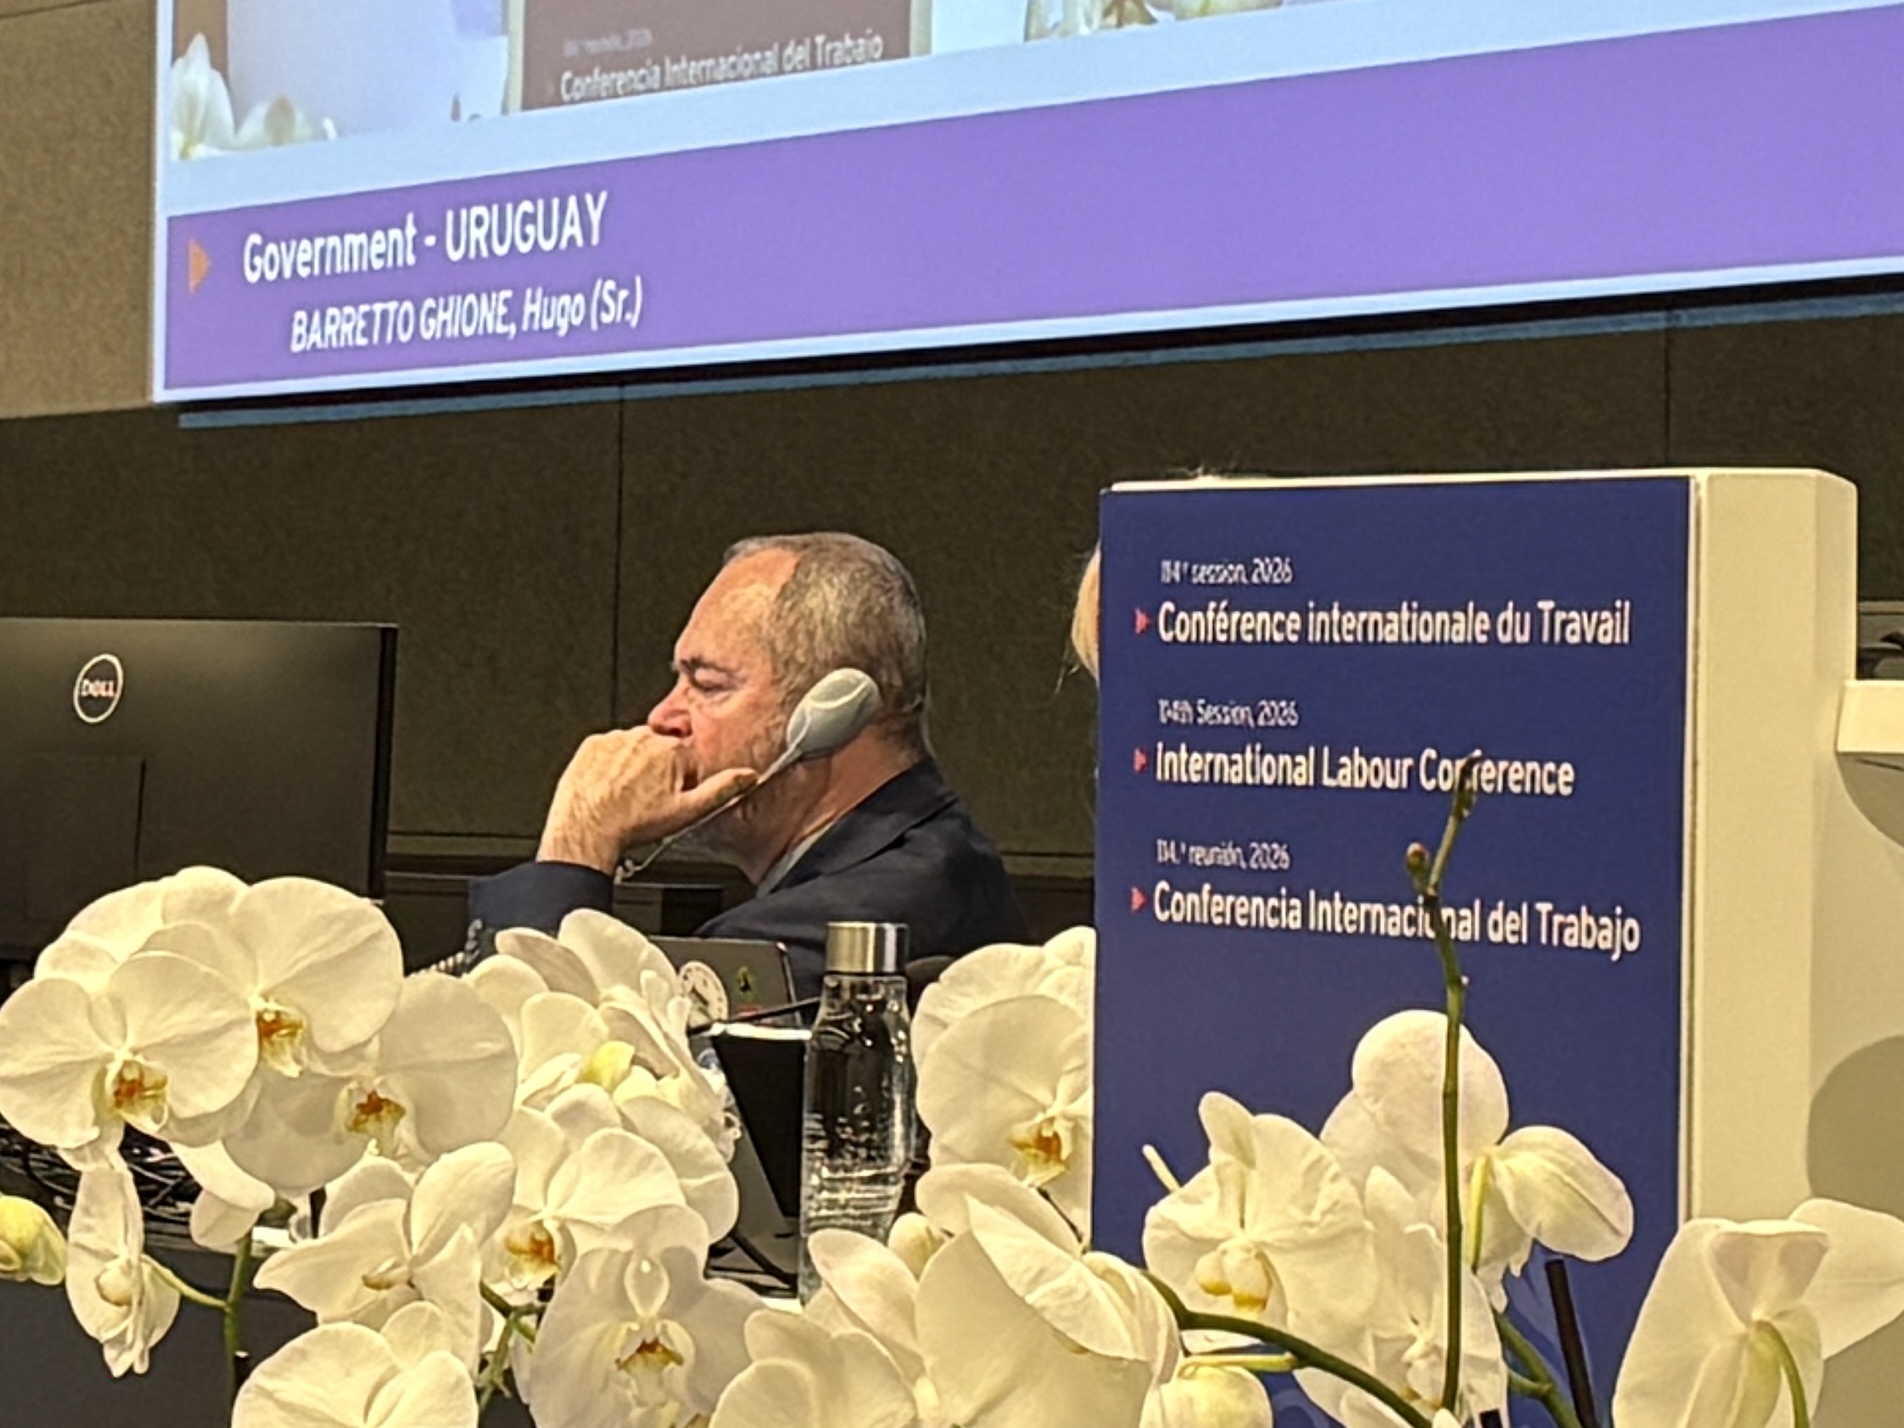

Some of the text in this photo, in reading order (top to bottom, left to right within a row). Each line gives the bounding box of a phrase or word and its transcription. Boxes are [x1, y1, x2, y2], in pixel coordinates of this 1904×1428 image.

[243, 190, 609, 284] Government - URUGUAY
[290, 275, 643, 352] BARRETTO GHIONE, Hugo (Sr.)
[1158, 599, 1631, 645] Conférence internationale du Travail
[1156, 741, 1315, 786] International
[1321, 745, 1413, 790] Labour
[1154, 880, 1303, 930] Conferencia
[1487, 900, 1528, 944] del
[1534, 902, 1641, 962] Trabajo
